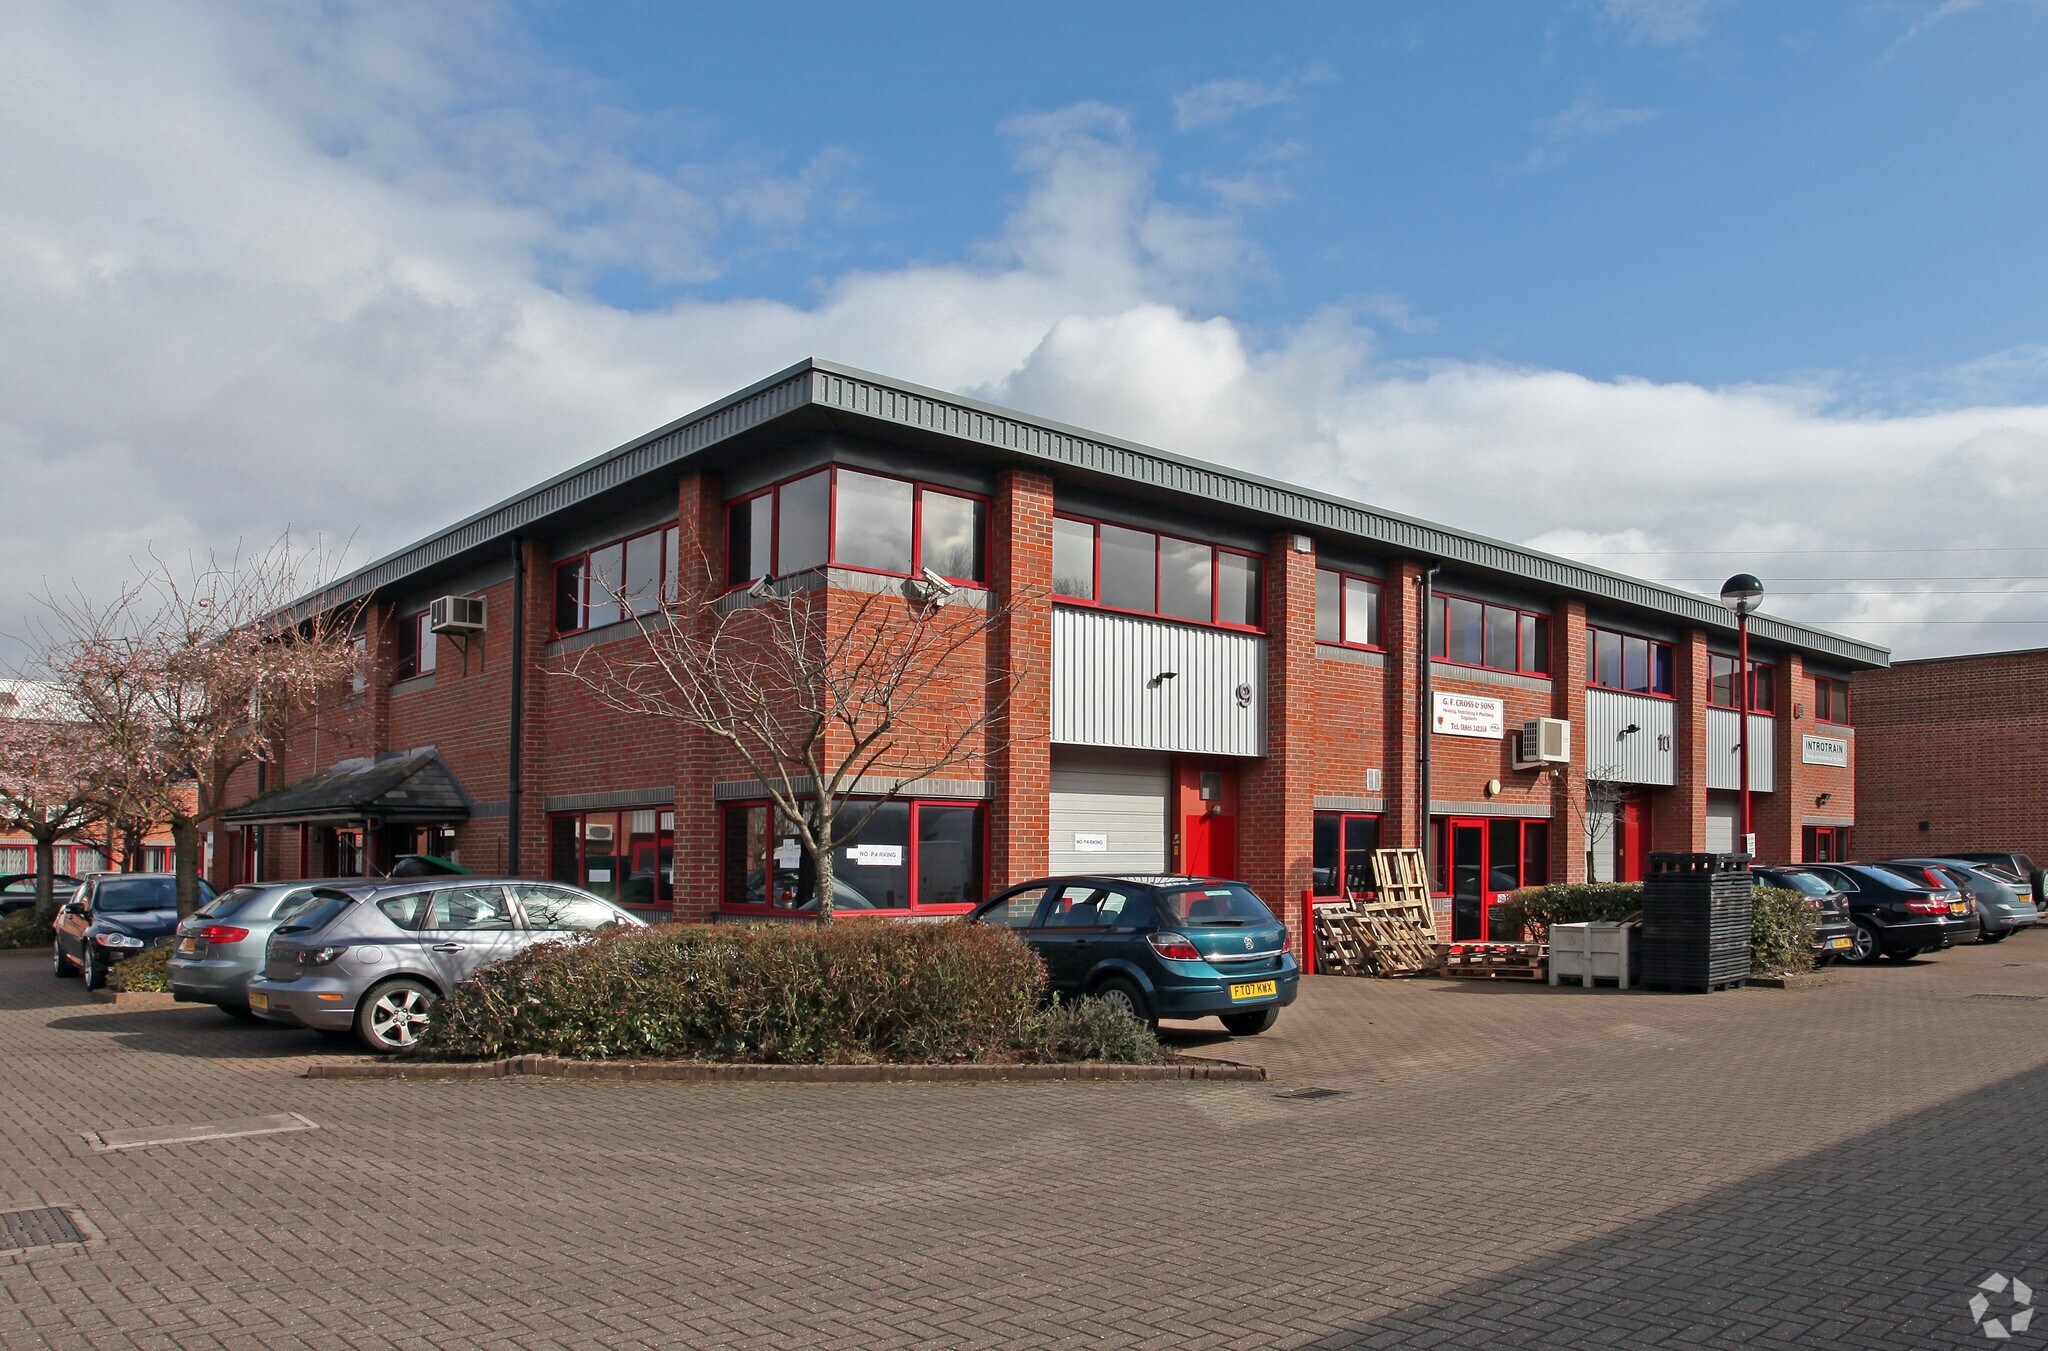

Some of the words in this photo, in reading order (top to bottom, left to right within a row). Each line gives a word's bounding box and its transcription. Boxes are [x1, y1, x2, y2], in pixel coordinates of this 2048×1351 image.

[1238, 682, 1252, 708] 9
[1443, 698, 1449, 706] G.
[1450, 698, 1456, 706] F.
[1456, 700, 1474, 708] CROSS
[1480, 702, 1494, 710] SONS
[1657, 734, 1670, 752] 10
[1806, 741, 1843, 753] INTROTRAIN
[1234, 984, 1255, 996] FT07
[1257, 982, 1272, 994] KWX
